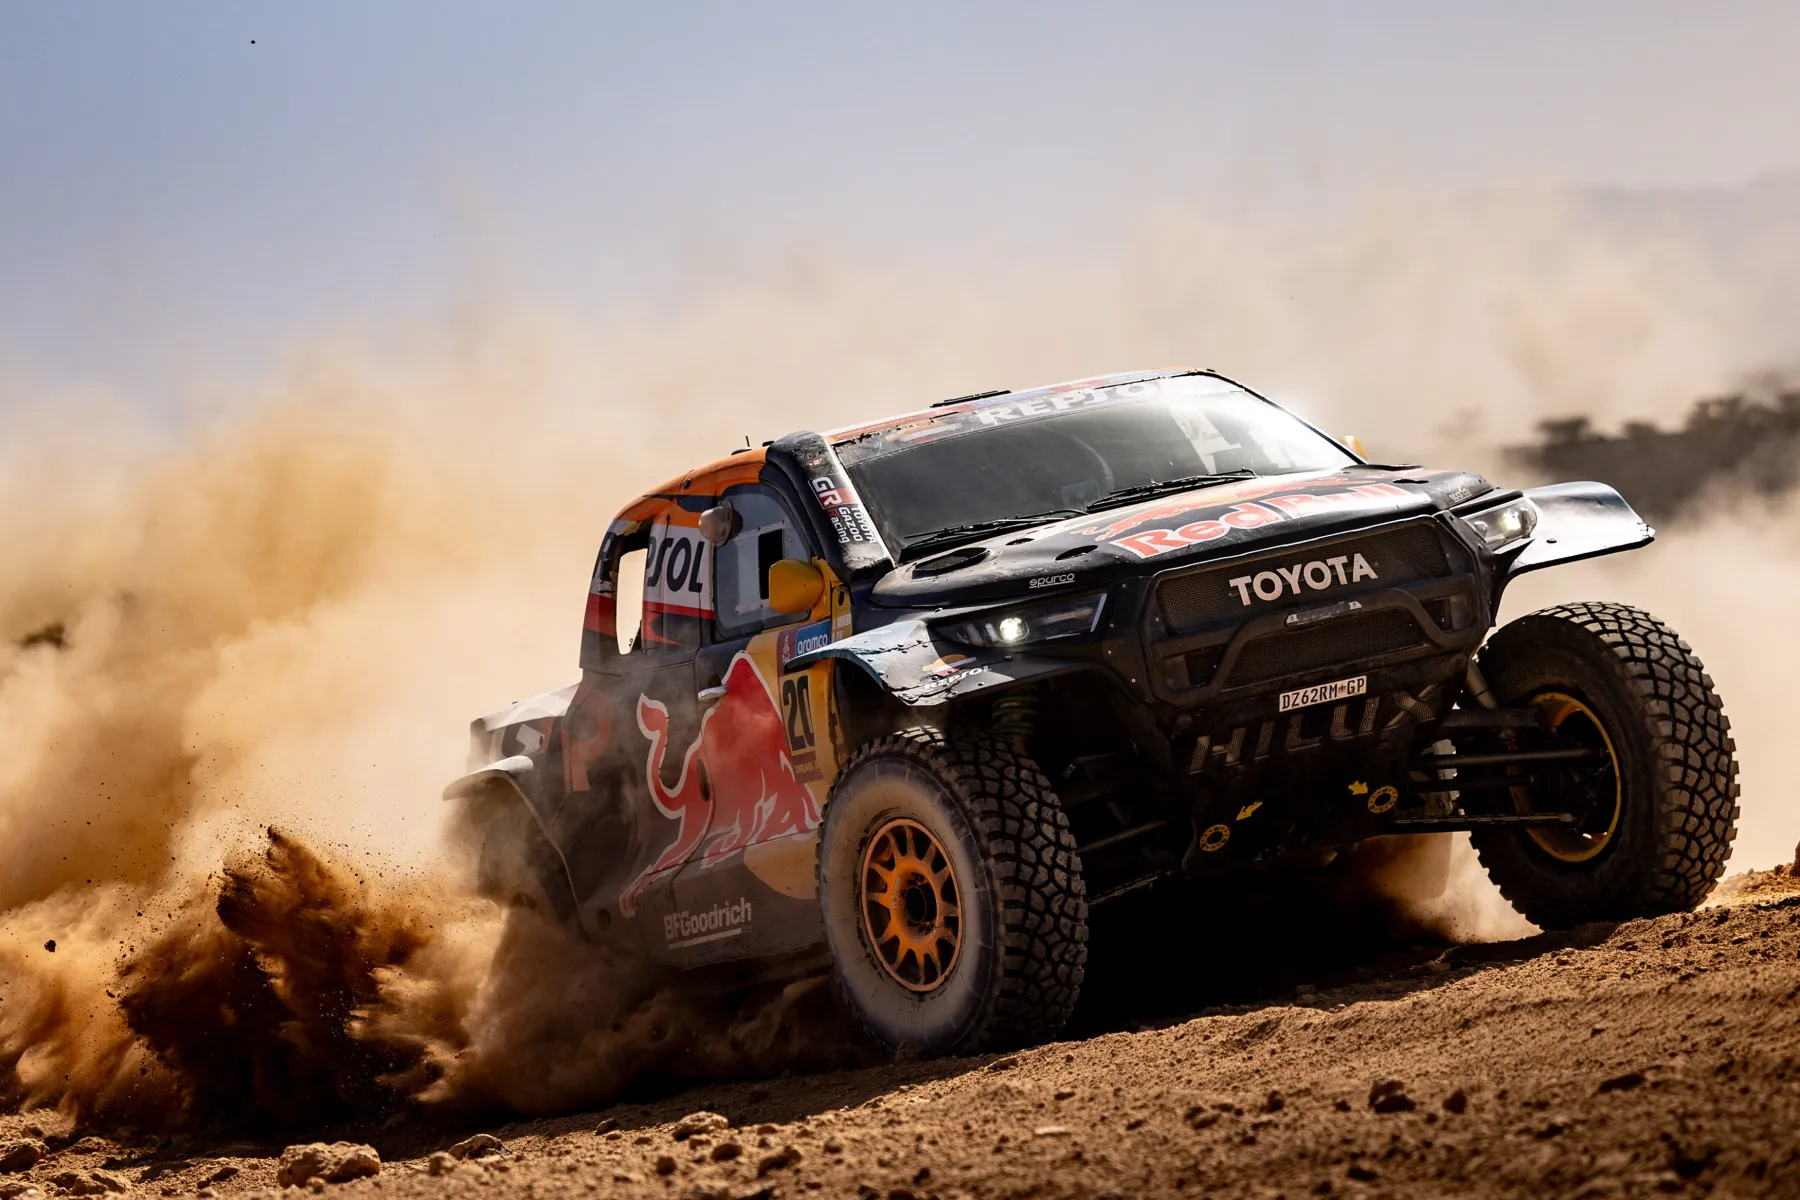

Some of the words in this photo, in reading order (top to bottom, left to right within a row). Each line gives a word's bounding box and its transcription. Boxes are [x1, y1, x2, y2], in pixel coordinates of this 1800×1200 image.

[812, 477, 843, 506] GR
[827, 508, 851, 544] Racing
[839, 507, 864, 542] GAZOO
[851, 505, 877, 544] TOYOTA
[1115, 500, 1281, 557] Red
[1029, 573, 1075, 588] sparco
[1229, 553, 1378, 606] TOYOTA
[797, 633, 829, 654] aramco
[783, 675, 816, 750] 20
[1189, 684, 1437, 774] HILUX
[664, 897, 752, 940] BFGoodrich
